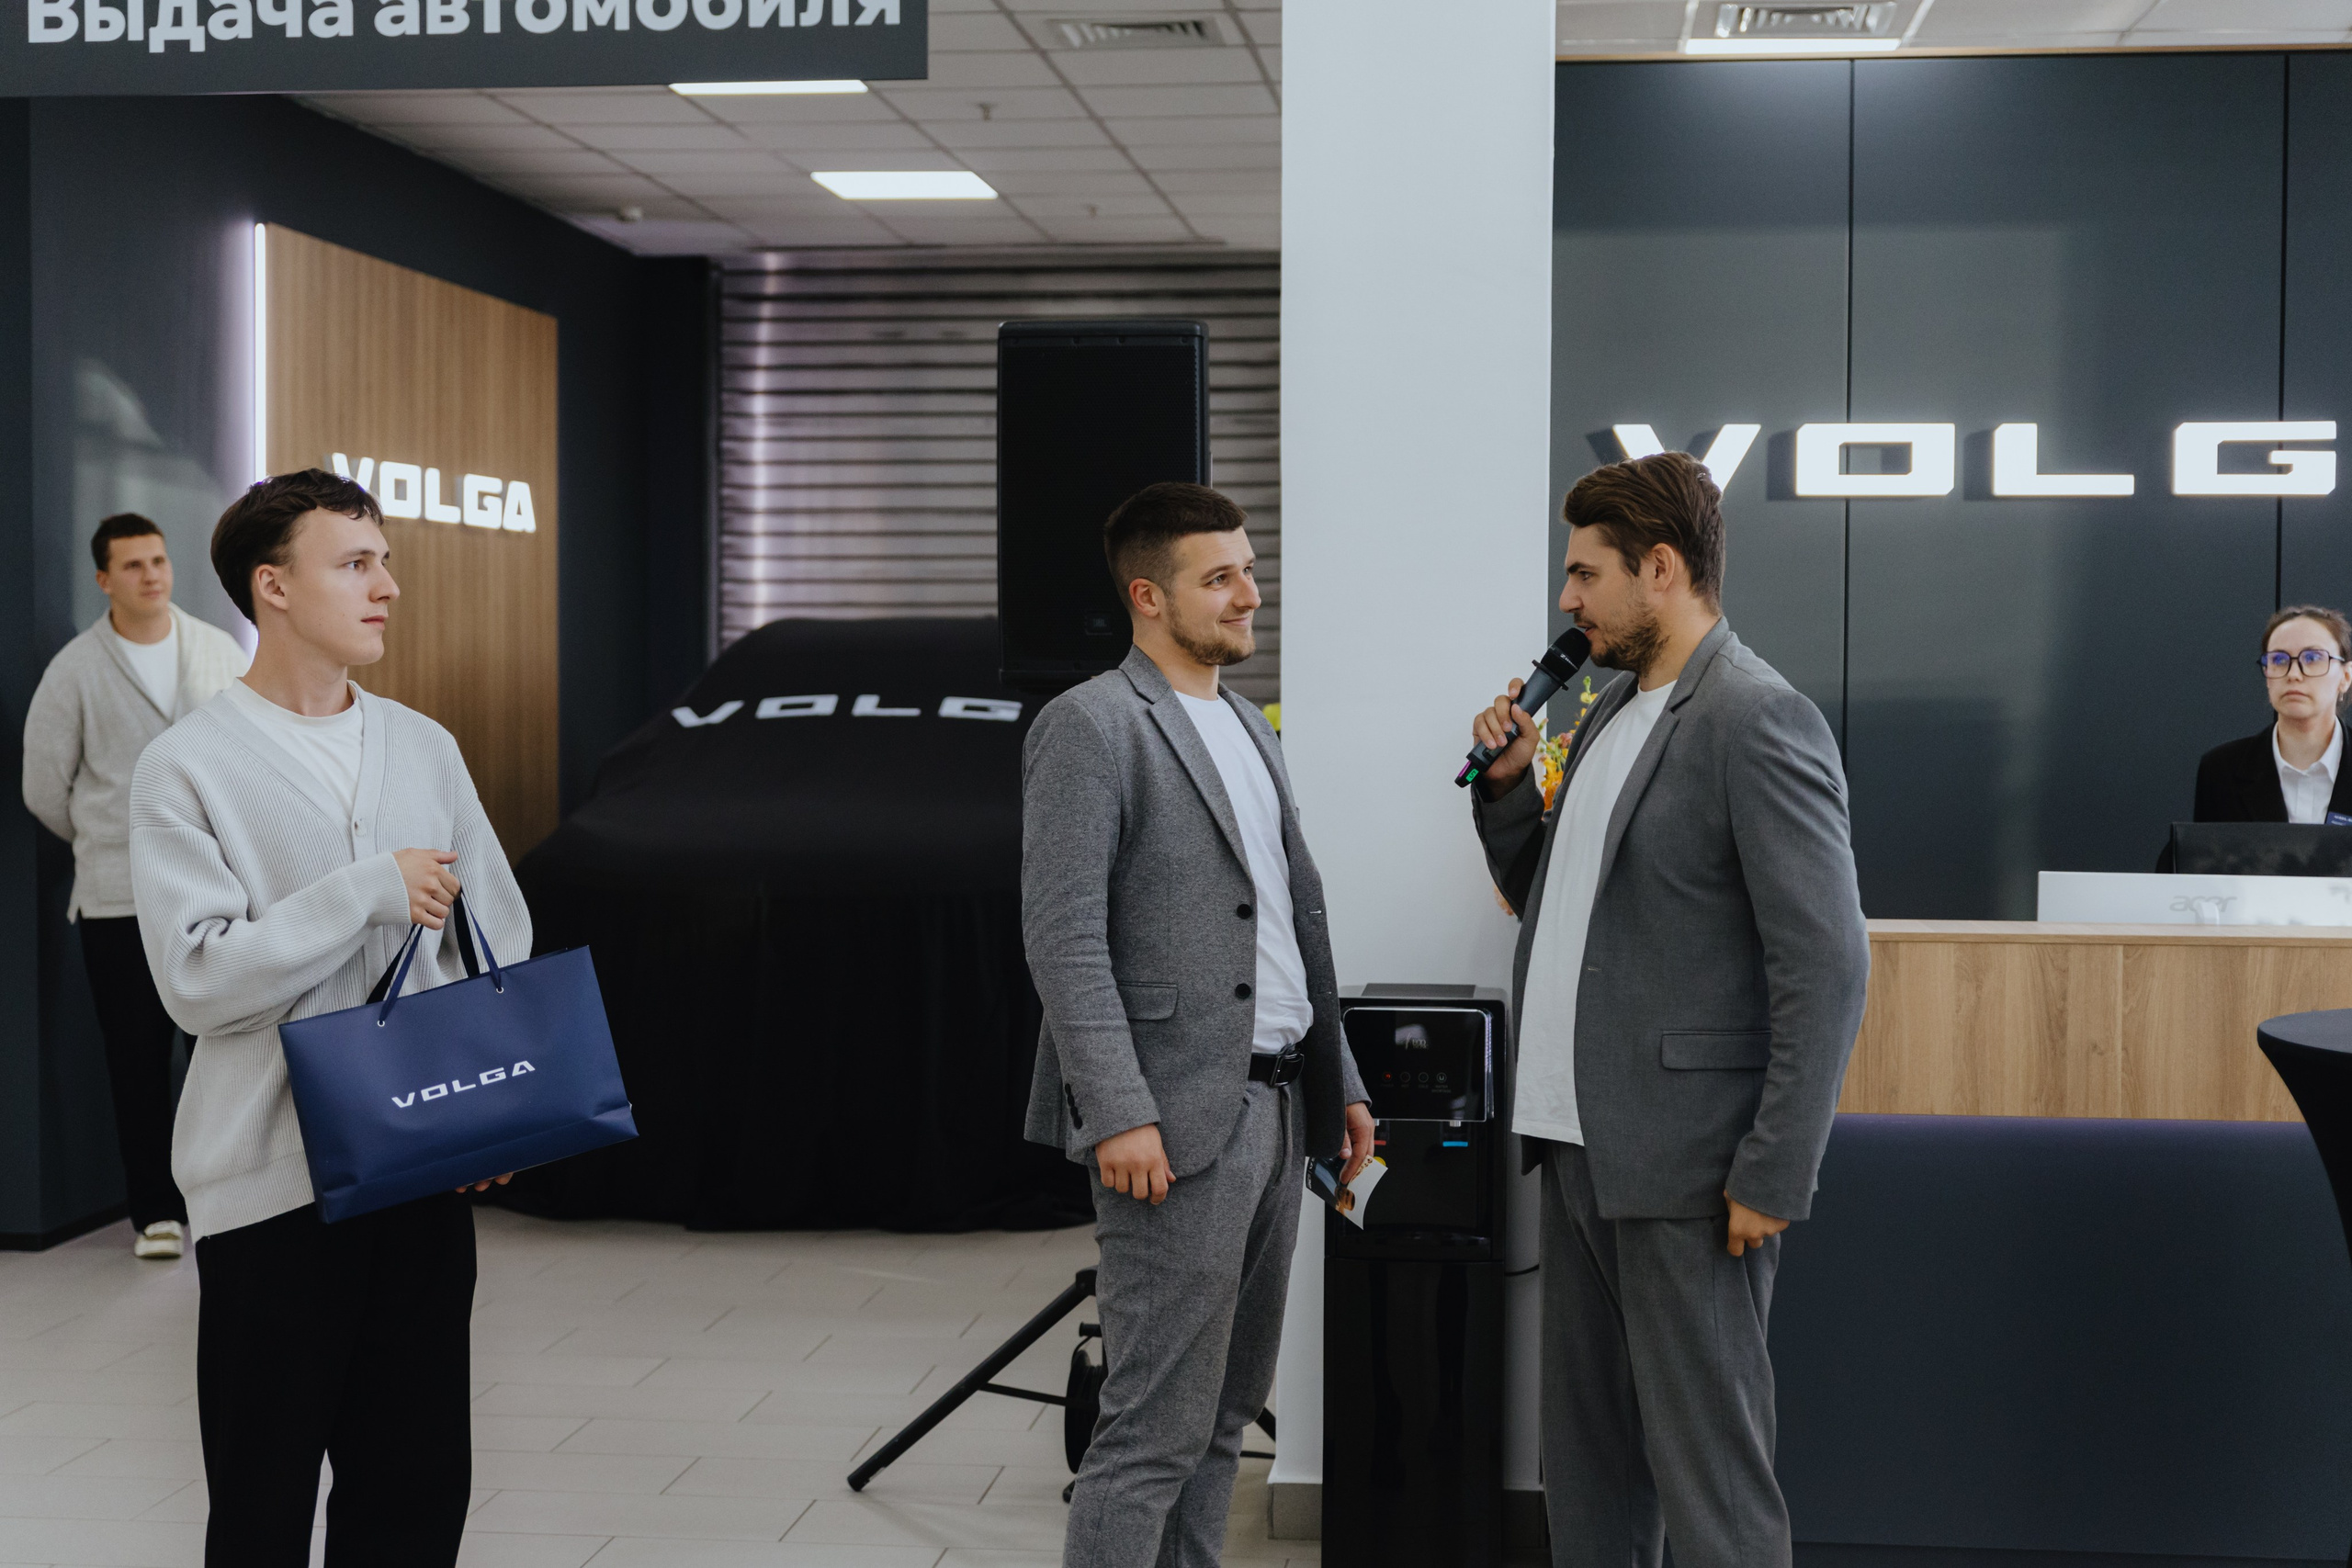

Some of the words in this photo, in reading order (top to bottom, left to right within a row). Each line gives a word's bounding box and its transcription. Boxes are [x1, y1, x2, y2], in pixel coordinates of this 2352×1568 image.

[28, 0, 355, 52] Выдача
[672, 694, 1022, 728] VOLG
[391, 1060, 536, 1109] VOLGA
